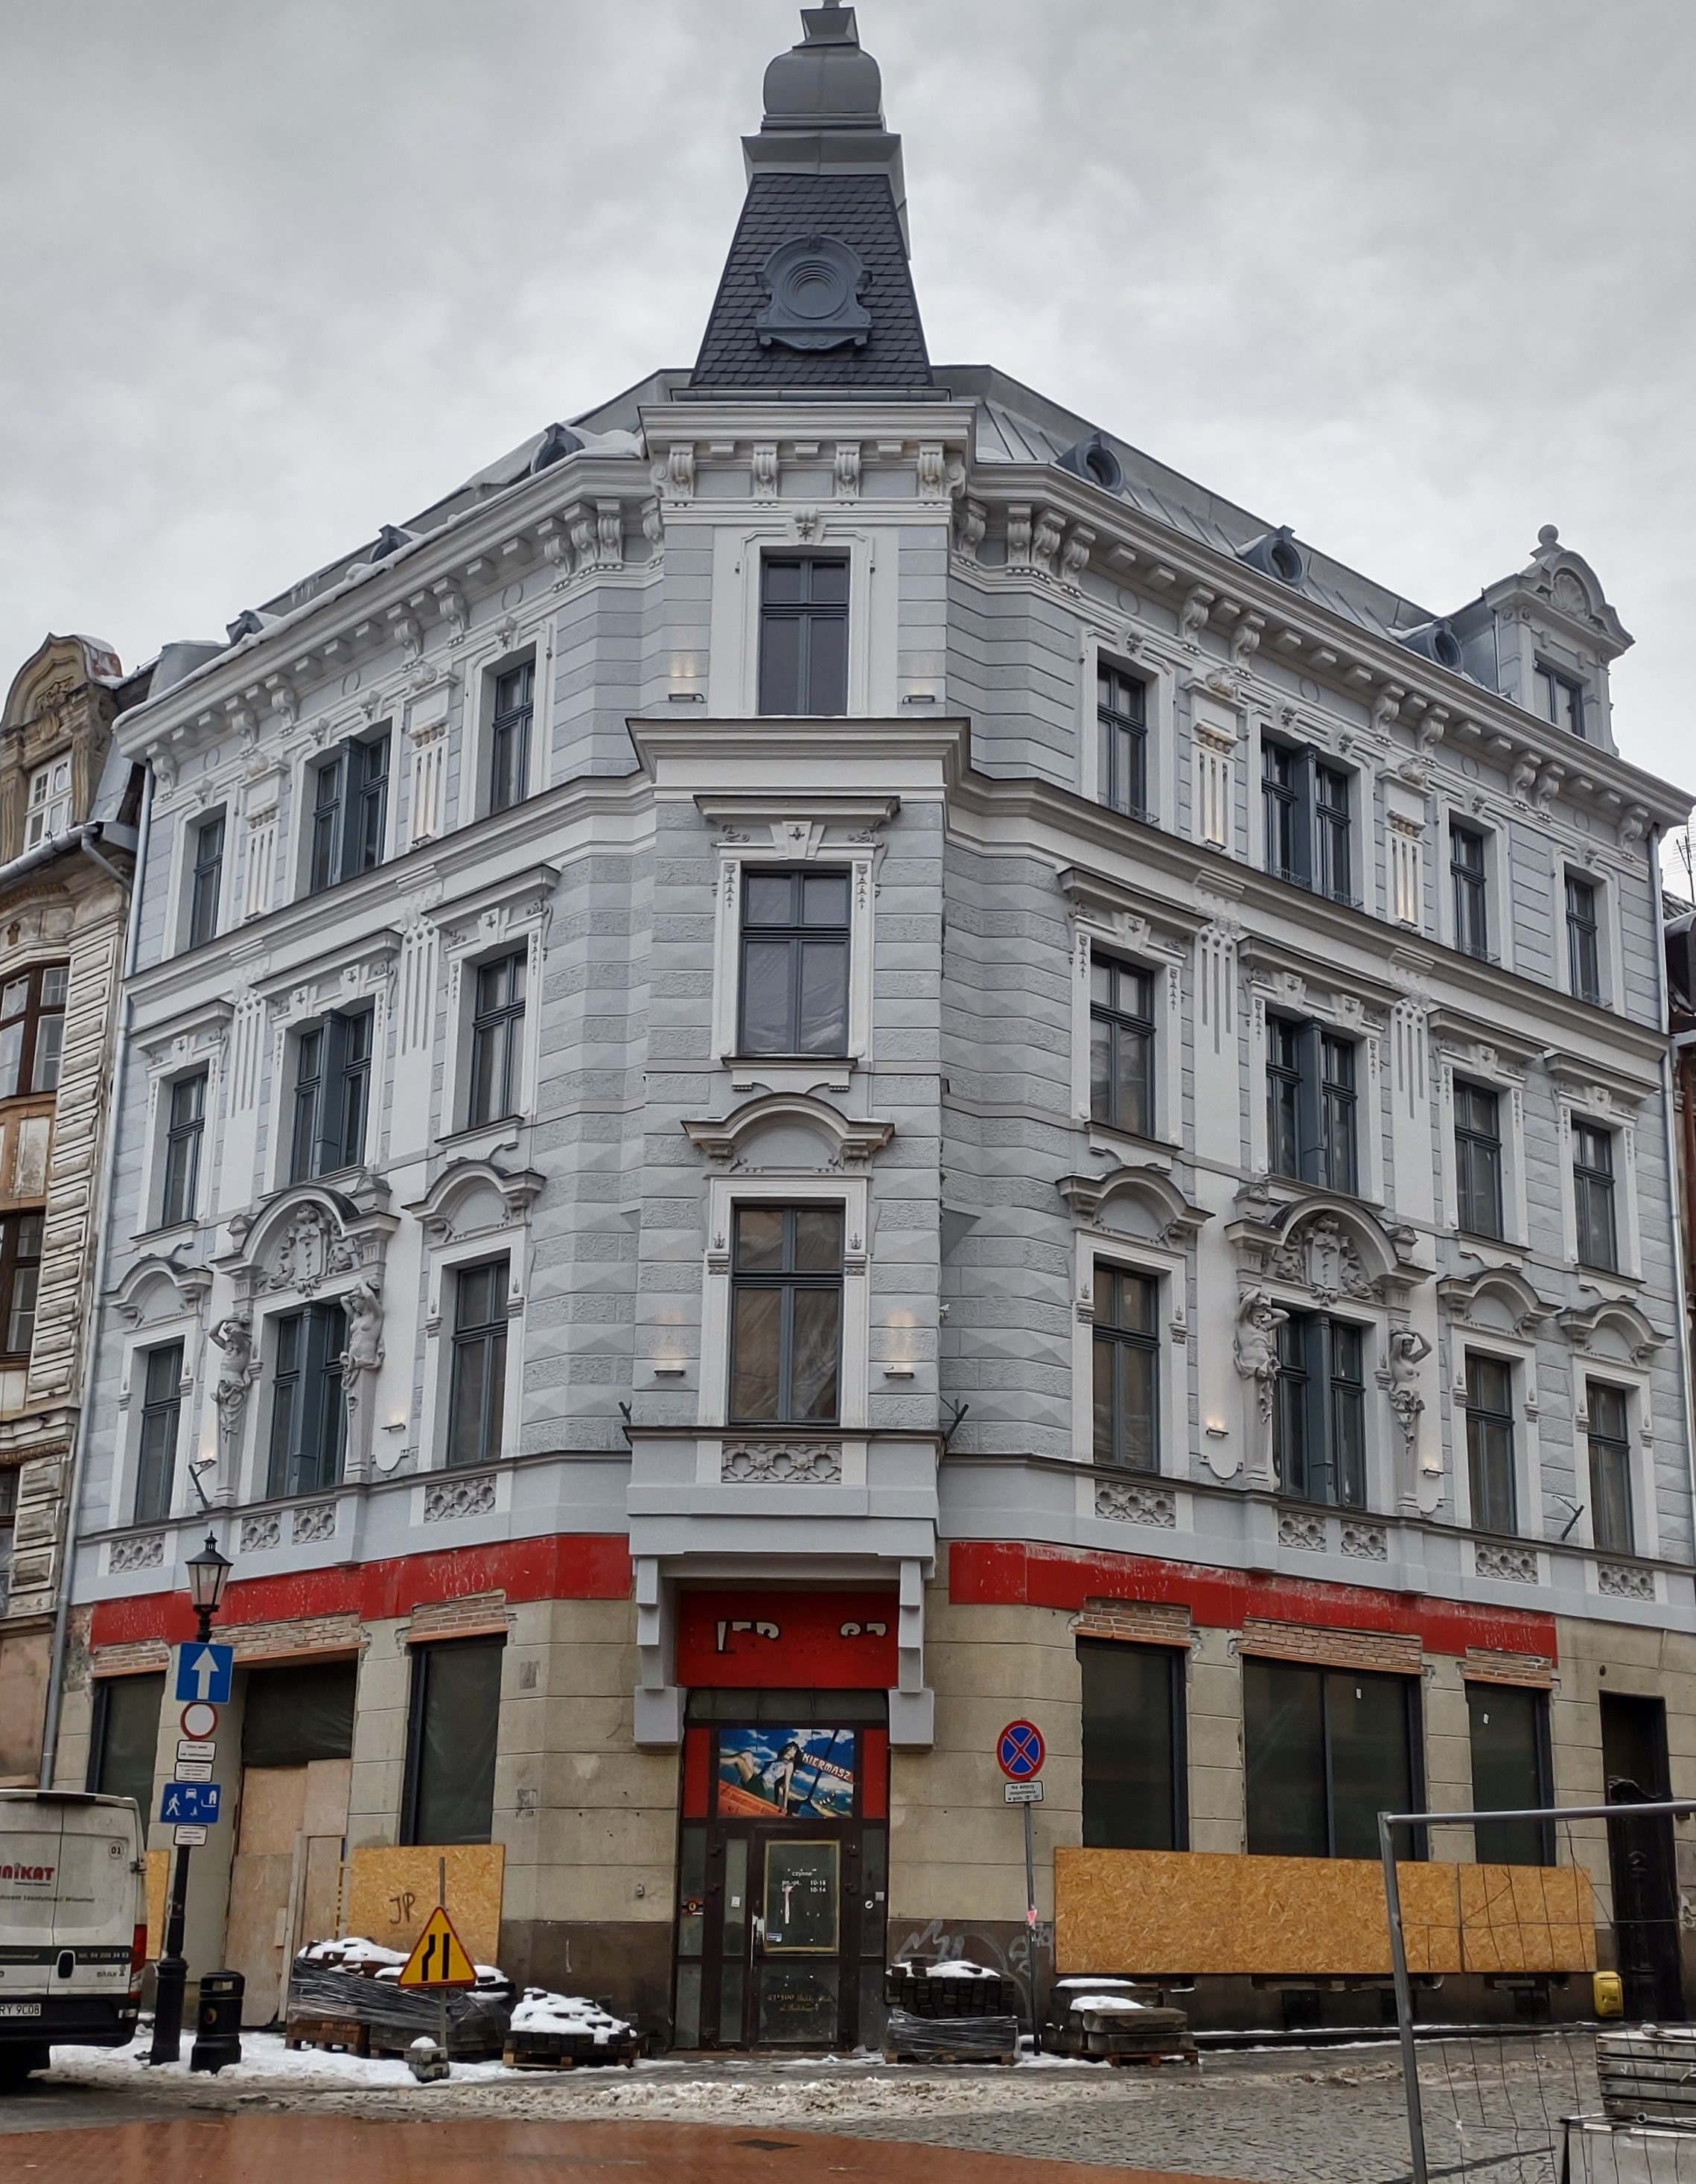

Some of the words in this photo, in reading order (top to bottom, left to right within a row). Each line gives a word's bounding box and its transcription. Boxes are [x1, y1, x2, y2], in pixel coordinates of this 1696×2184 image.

[803, 1754, 851, 1780] KIERMASZ
[111, 1846, 121, 1855] 01
[389, 1892, 415, 1924] JP
